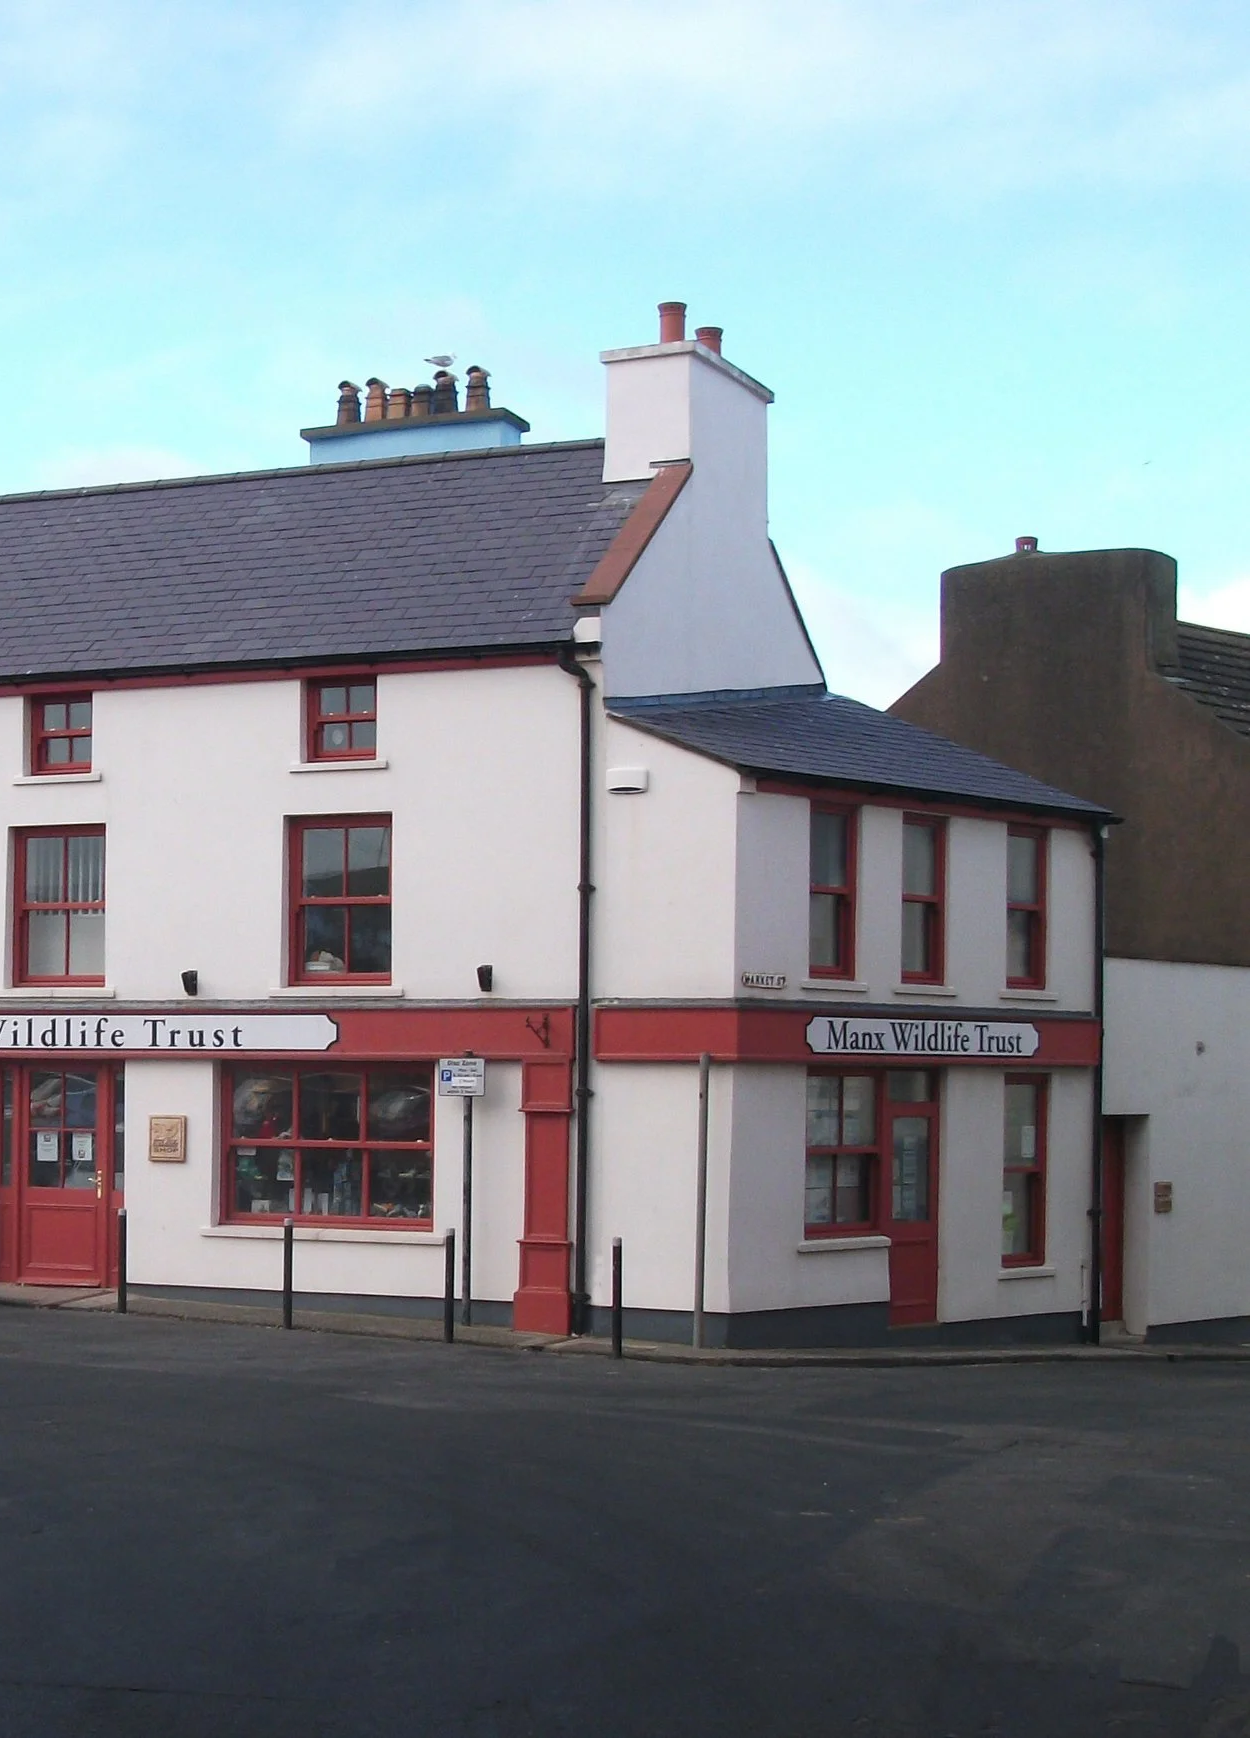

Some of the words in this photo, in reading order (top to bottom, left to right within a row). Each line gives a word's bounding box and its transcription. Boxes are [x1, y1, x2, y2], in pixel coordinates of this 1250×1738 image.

[143, 1018, 243, 1048] Trust
[826, 1020, 885, 1051] Manx
[889, 1021, 971, 1053] Wildlife
[974, 1024, 1023, 1053] Trust
